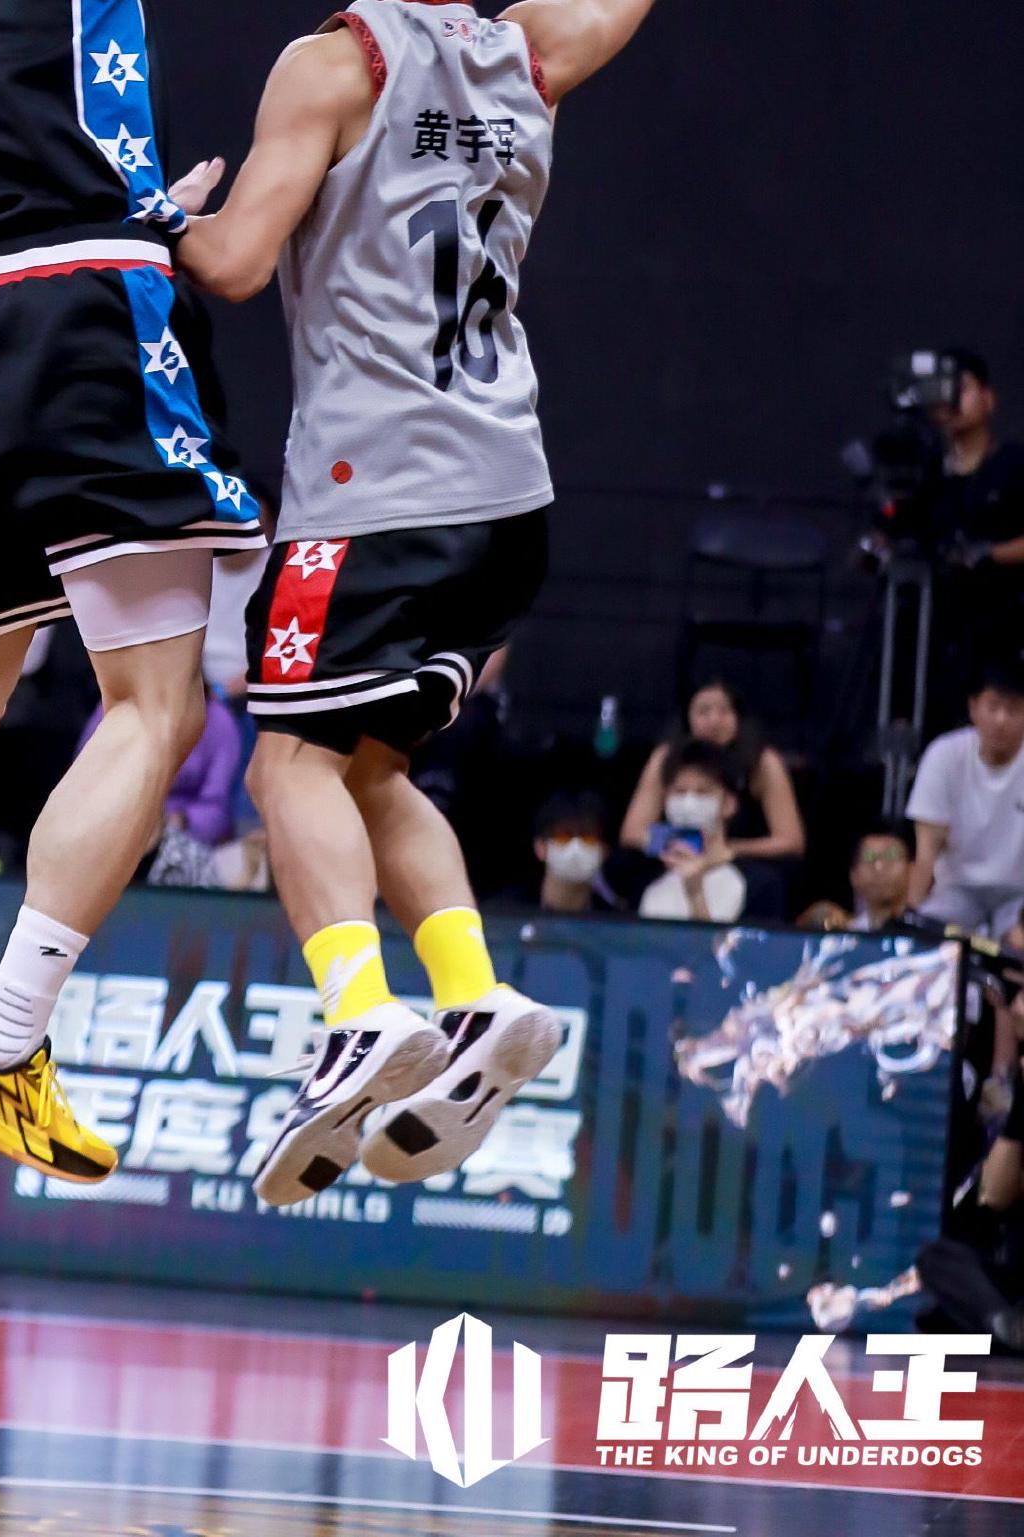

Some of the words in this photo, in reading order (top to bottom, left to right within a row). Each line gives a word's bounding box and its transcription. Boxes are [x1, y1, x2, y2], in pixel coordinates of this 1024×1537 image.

[407, 199, 508, 392] 16
[191, 1177, 245, 1213] KU
[257, 1187, 392, 1224] NALS
